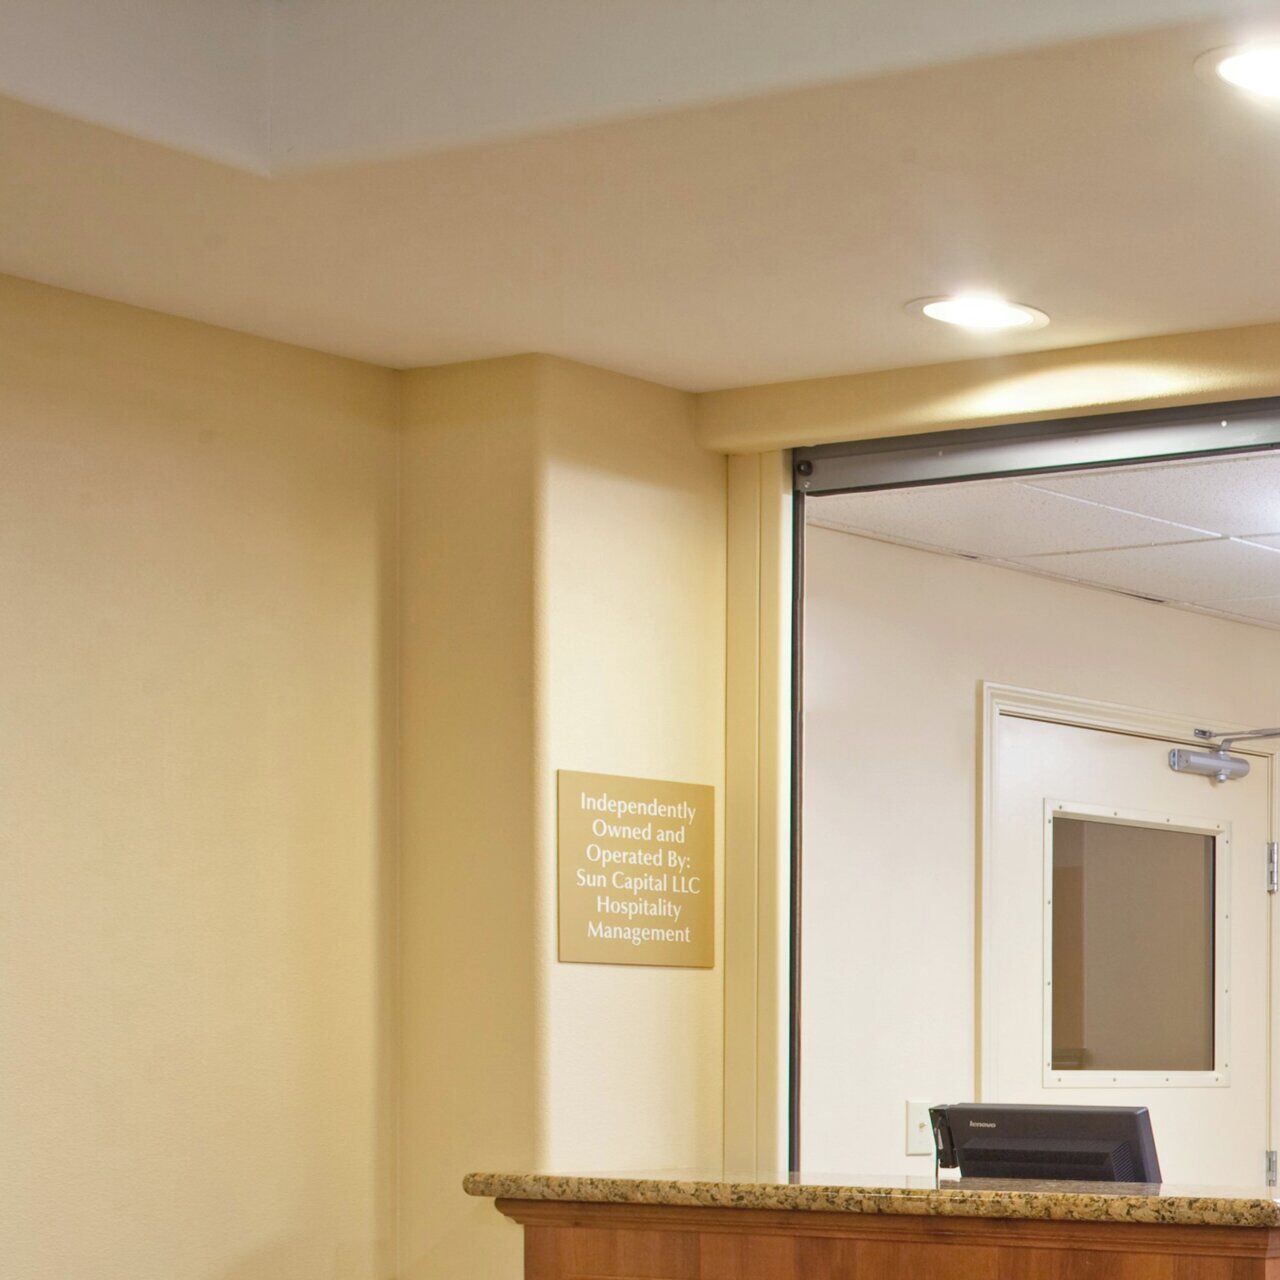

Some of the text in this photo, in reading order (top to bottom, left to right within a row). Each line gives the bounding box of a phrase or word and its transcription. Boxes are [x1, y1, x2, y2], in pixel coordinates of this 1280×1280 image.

[581, 792, 696, 825] Independently
[592, 819, 685, 844] Owned and
[586, 844, 691, 873] Operated By:
[576, 868, 700, 895] Sun Capital LLC
[597, 896, 682, 922] Hospitality
[587, 921, 691, 946] Management
[969, 1120, 996, 1128] lenovo
